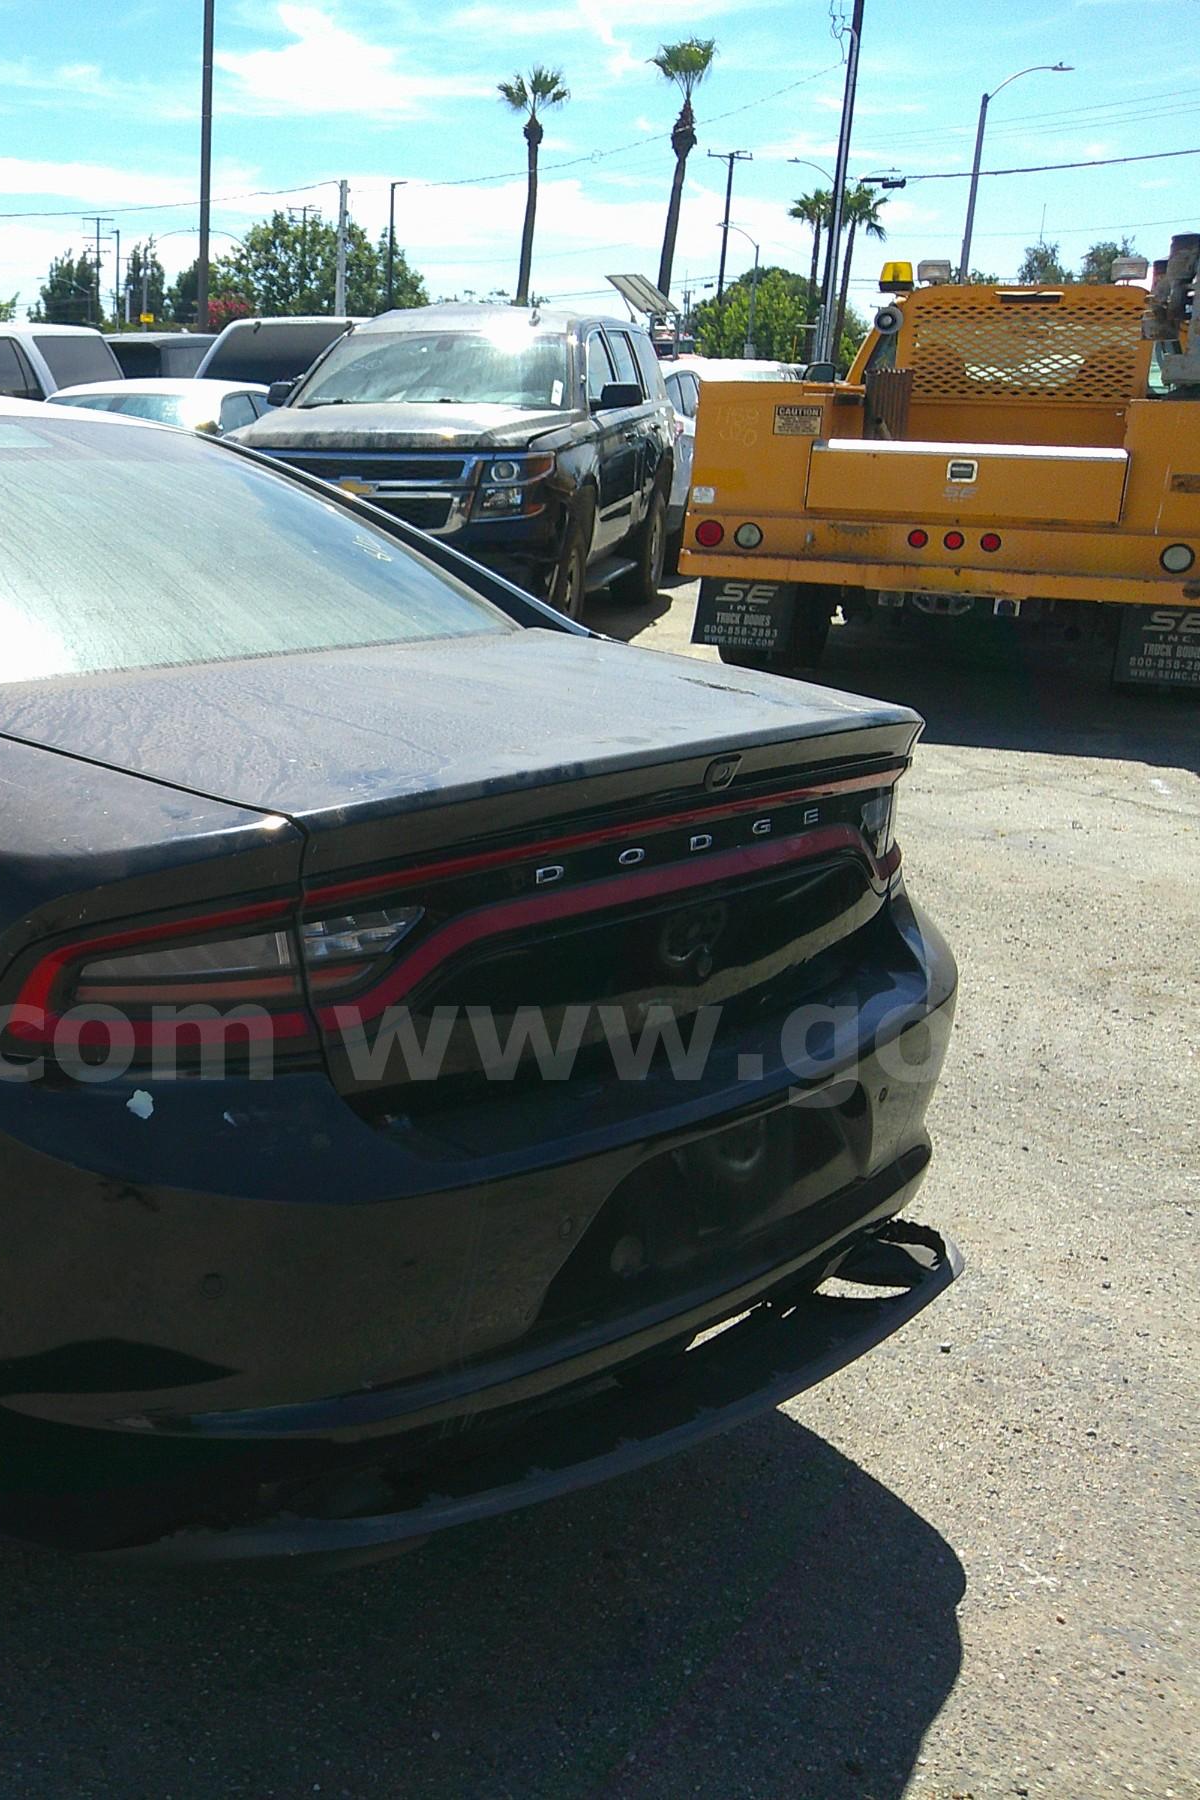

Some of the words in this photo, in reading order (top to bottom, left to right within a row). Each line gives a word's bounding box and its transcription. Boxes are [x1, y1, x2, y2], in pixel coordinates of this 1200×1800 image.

[778, 406, 820, 416] CAUTION
[715, 583, 779, 604] SE
[716, 612, 740, 625] TRUCK
[743, 613, 772, 627] BODIES
[1142, 611, 1200, 633] SE
[1144, 643, 1173, 657] TRUCK
[536, 808, 819, 884] DODGE
